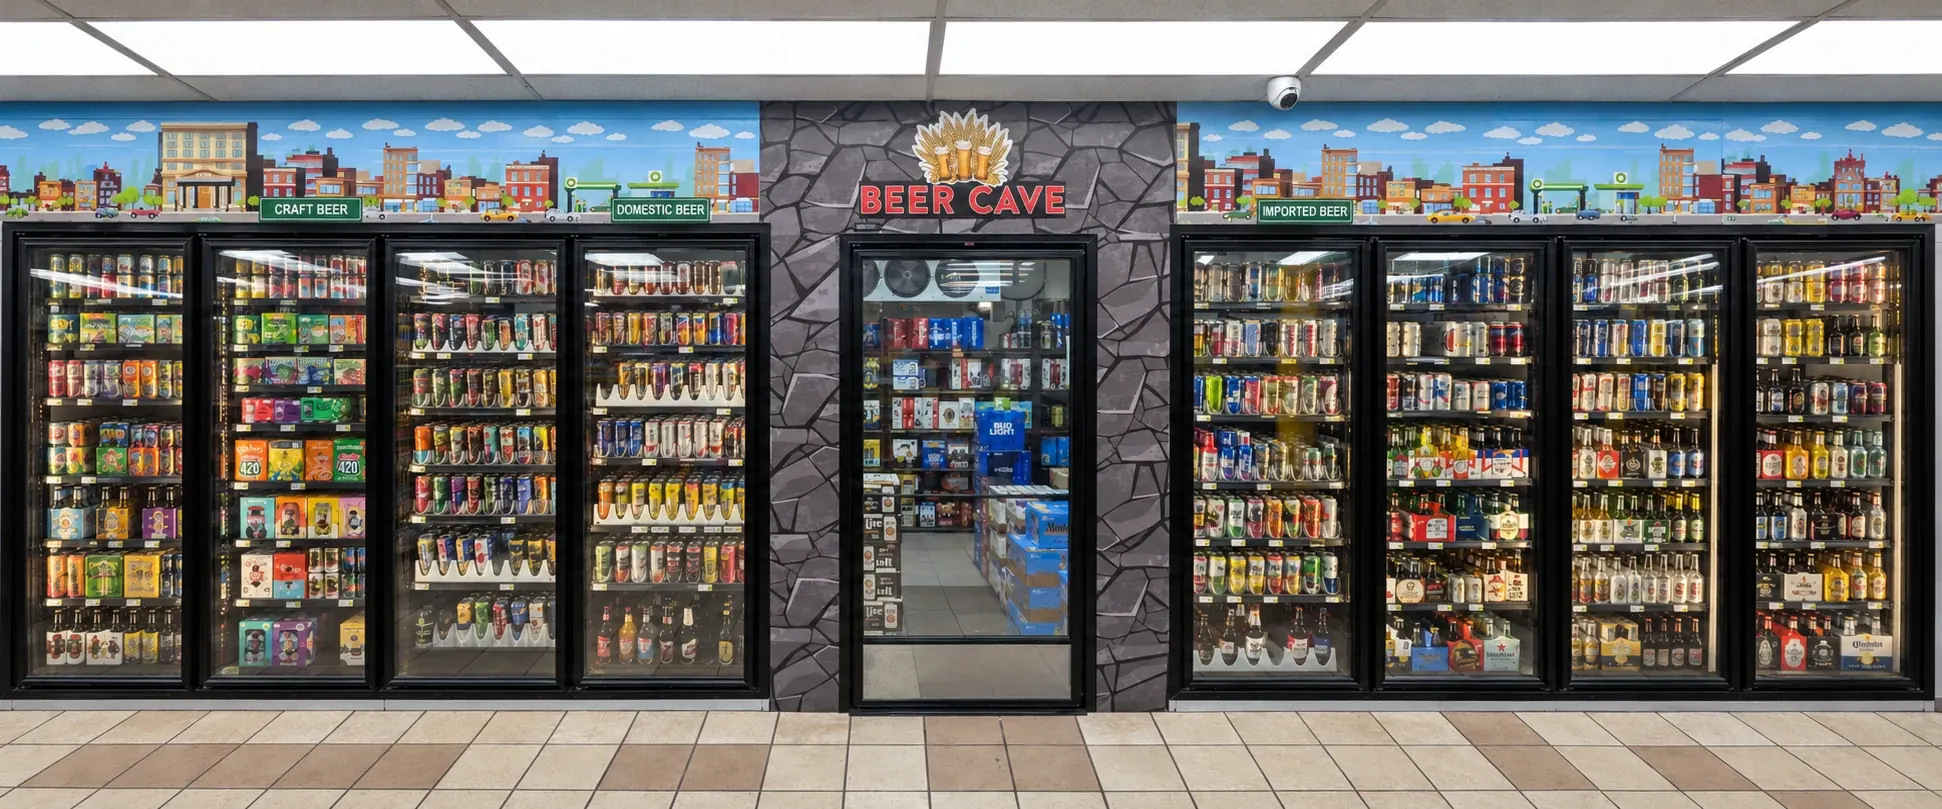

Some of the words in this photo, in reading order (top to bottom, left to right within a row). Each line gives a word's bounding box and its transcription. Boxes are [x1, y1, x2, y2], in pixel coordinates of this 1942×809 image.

[861, 185, 954, 214] BEER
[968, 185, 1065, 214] CAVE
[274, 204, 313, 215] CRAFT
[316, 204, 348, 215] BEER
[617, 204, 672, 215] DOMESTIC
[675, 204, 705, 215] BEER
[1263, 205, 1316, 217] IMPORTED
[1319, 205, 1348, 217] BEER
[989, 428, 1014, 436] LIGHT
[240, 461, 260, 475] 420
[338, 460, 358, 474] 420
